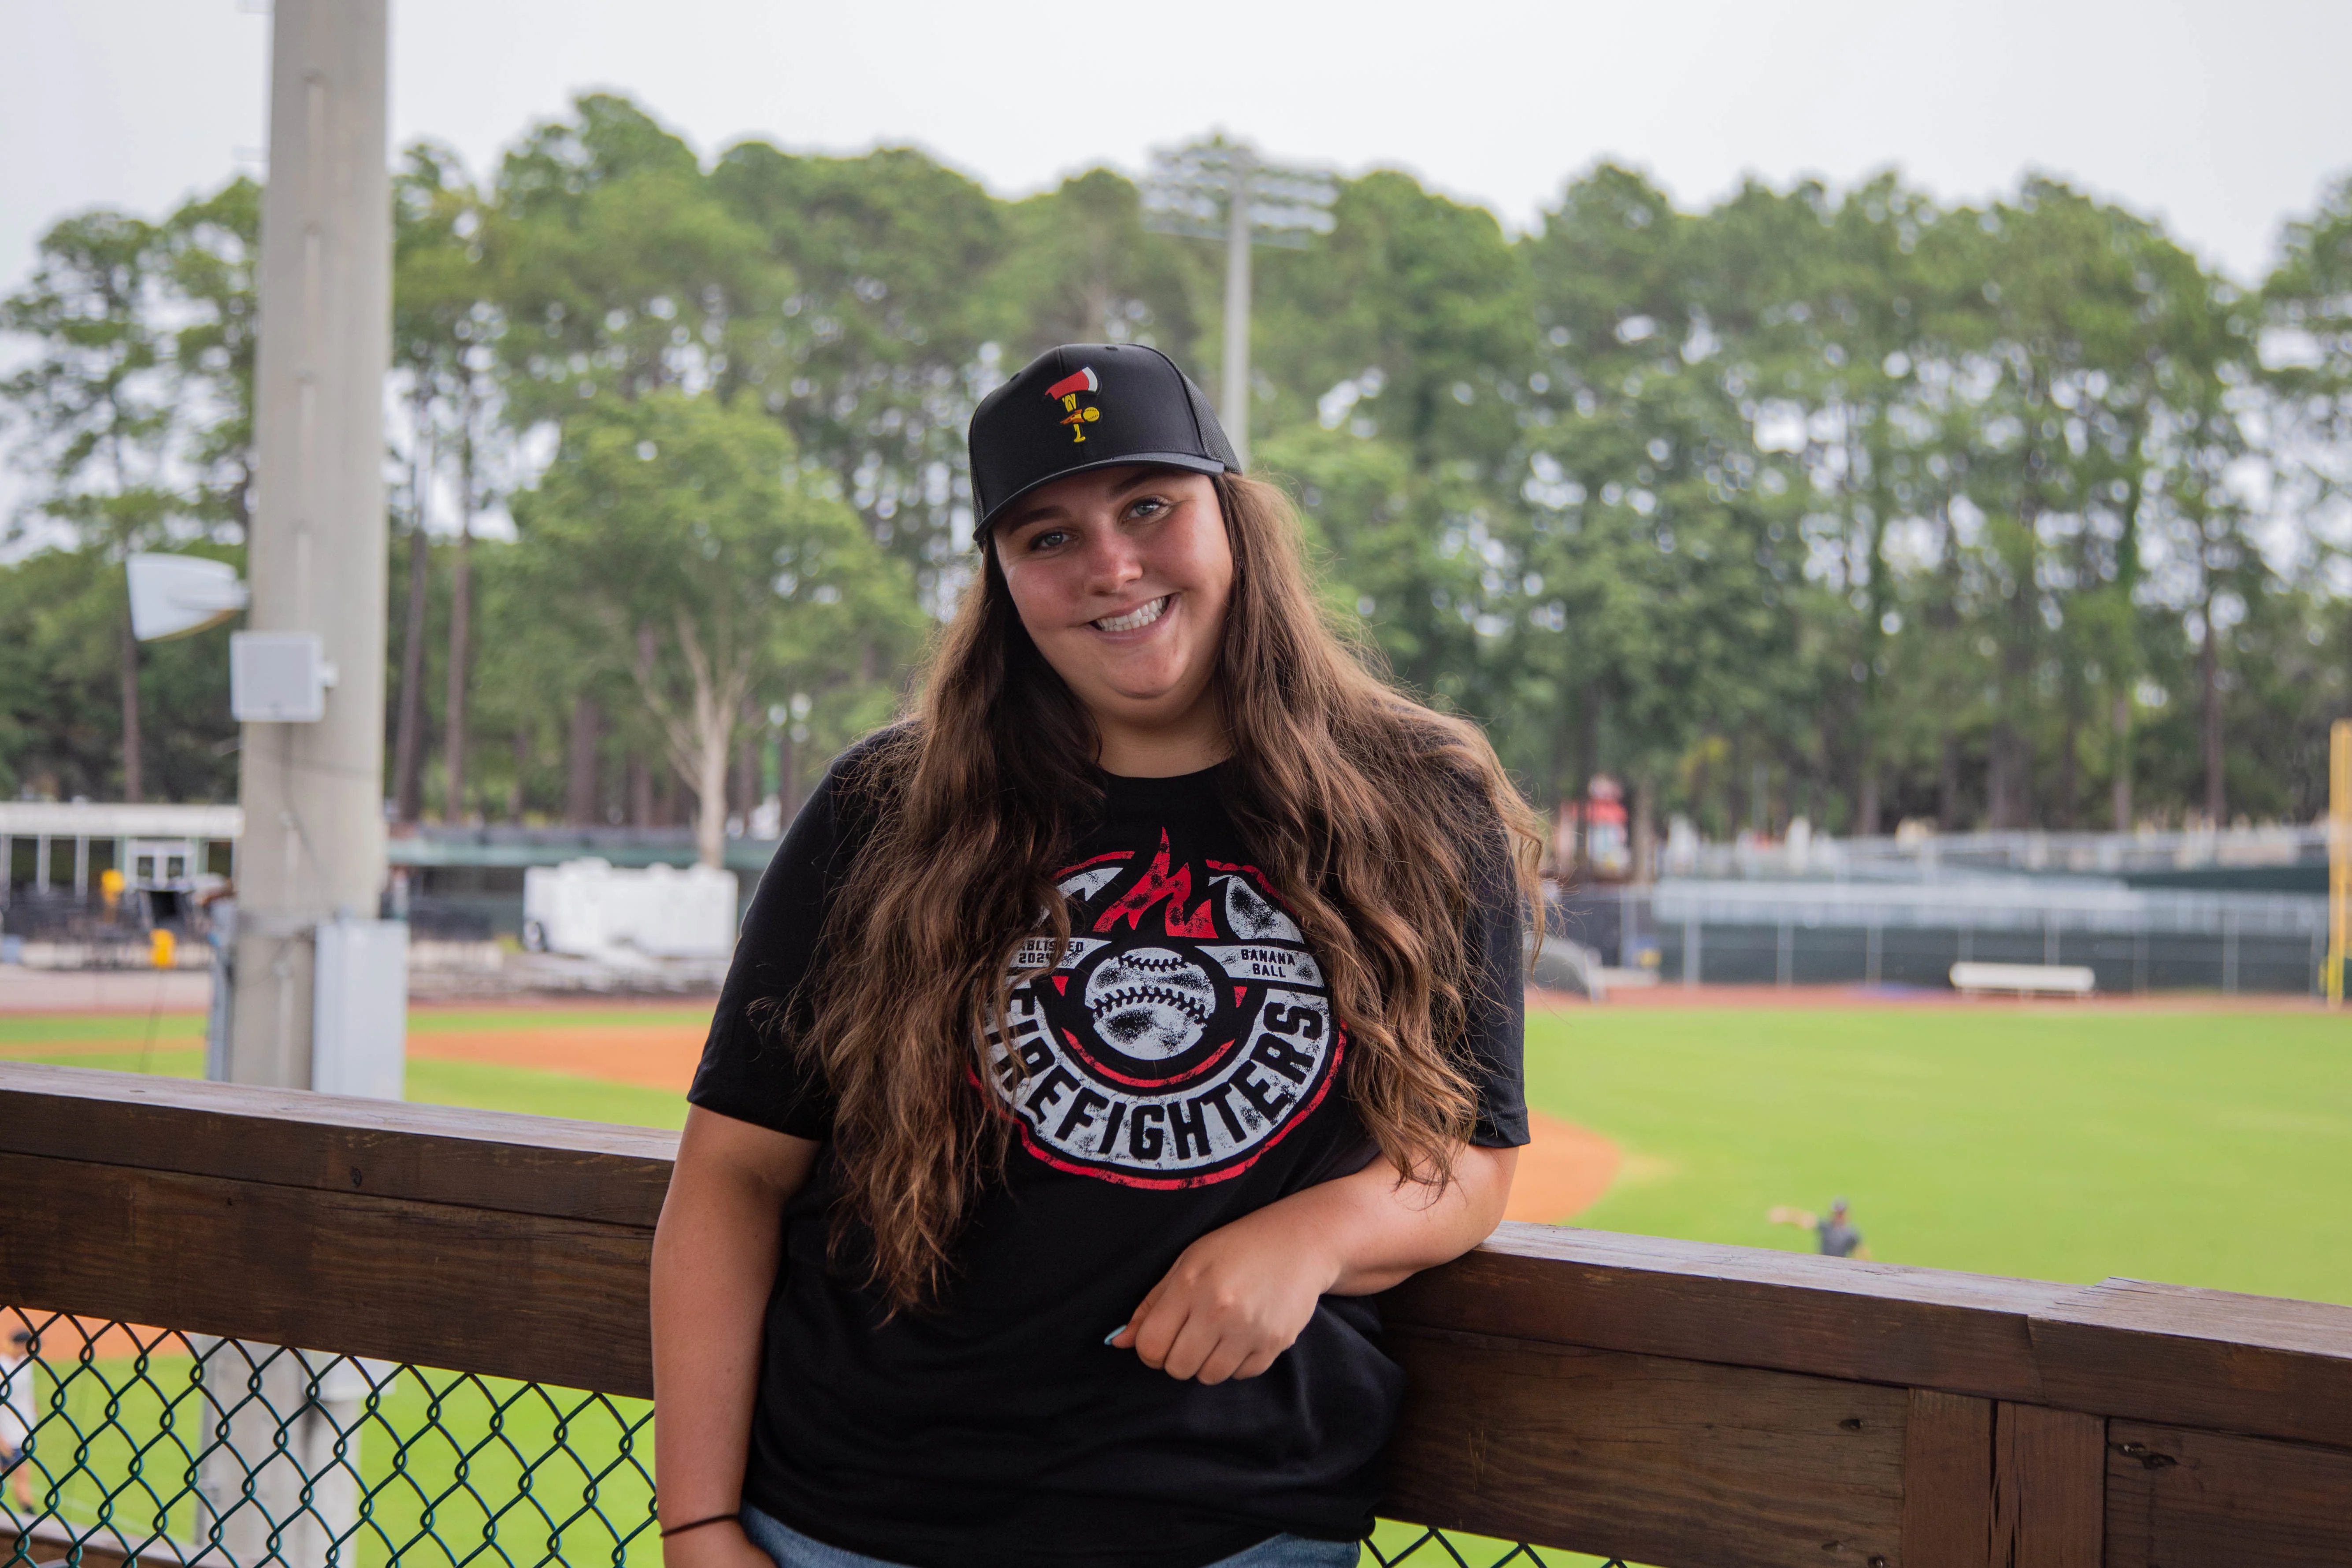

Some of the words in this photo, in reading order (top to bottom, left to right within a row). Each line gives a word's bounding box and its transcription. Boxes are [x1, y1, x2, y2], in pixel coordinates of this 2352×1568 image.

[1022, 940, 1084, 953] BLISED
[1241, 949, 1296, 966] BANANA
[1252, 963, 1286, 978] BALL
